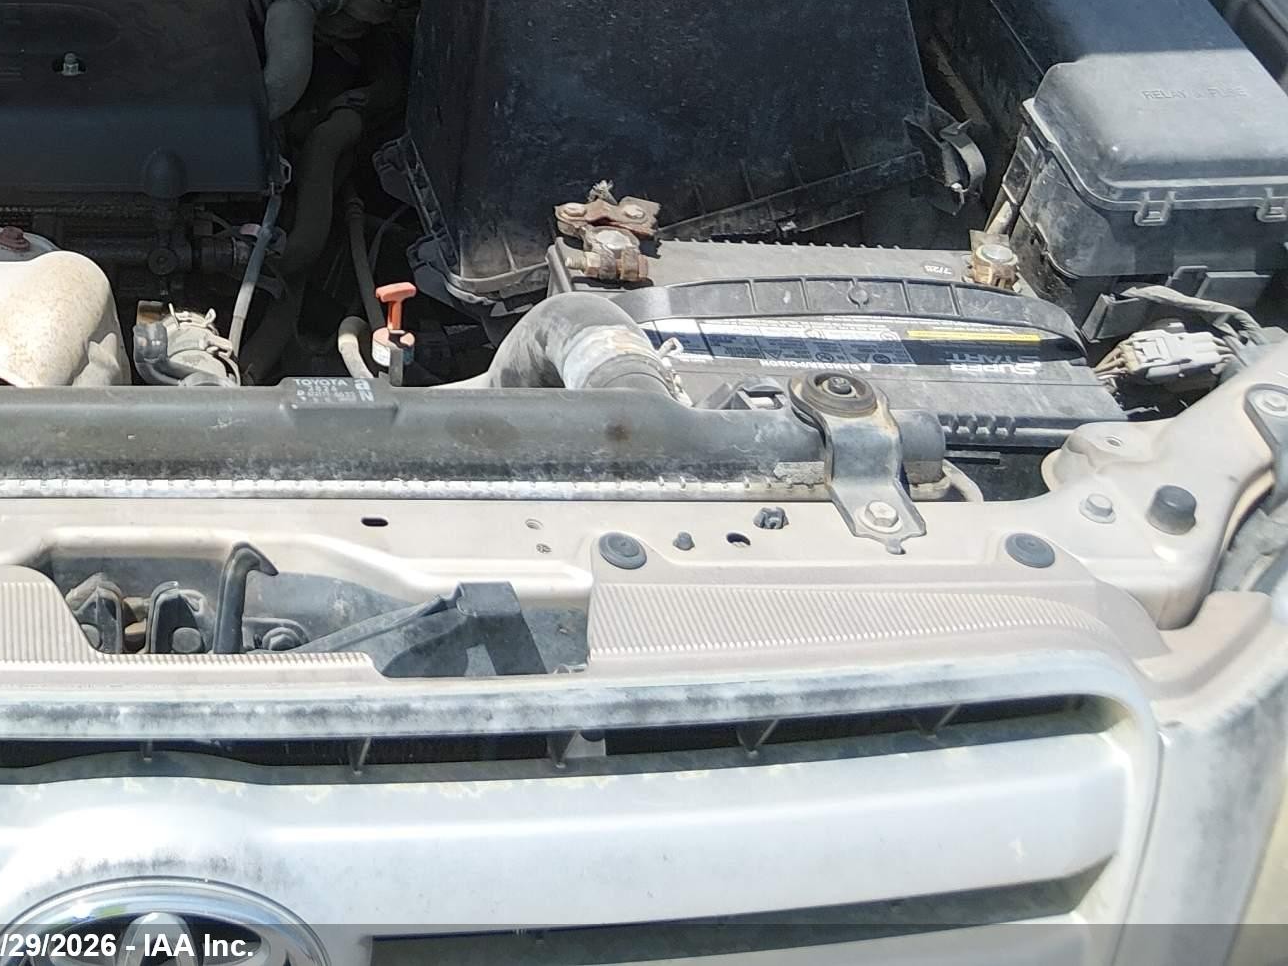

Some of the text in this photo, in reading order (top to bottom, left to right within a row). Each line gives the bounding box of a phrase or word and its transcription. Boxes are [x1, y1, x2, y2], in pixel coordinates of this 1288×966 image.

[1141, 89, 1186, 99] RELAY
[946, 353, 1040, 363] START
[950, 361, 1041, 375] SUPER
[293, 378, 348, 387] TOYOTA
